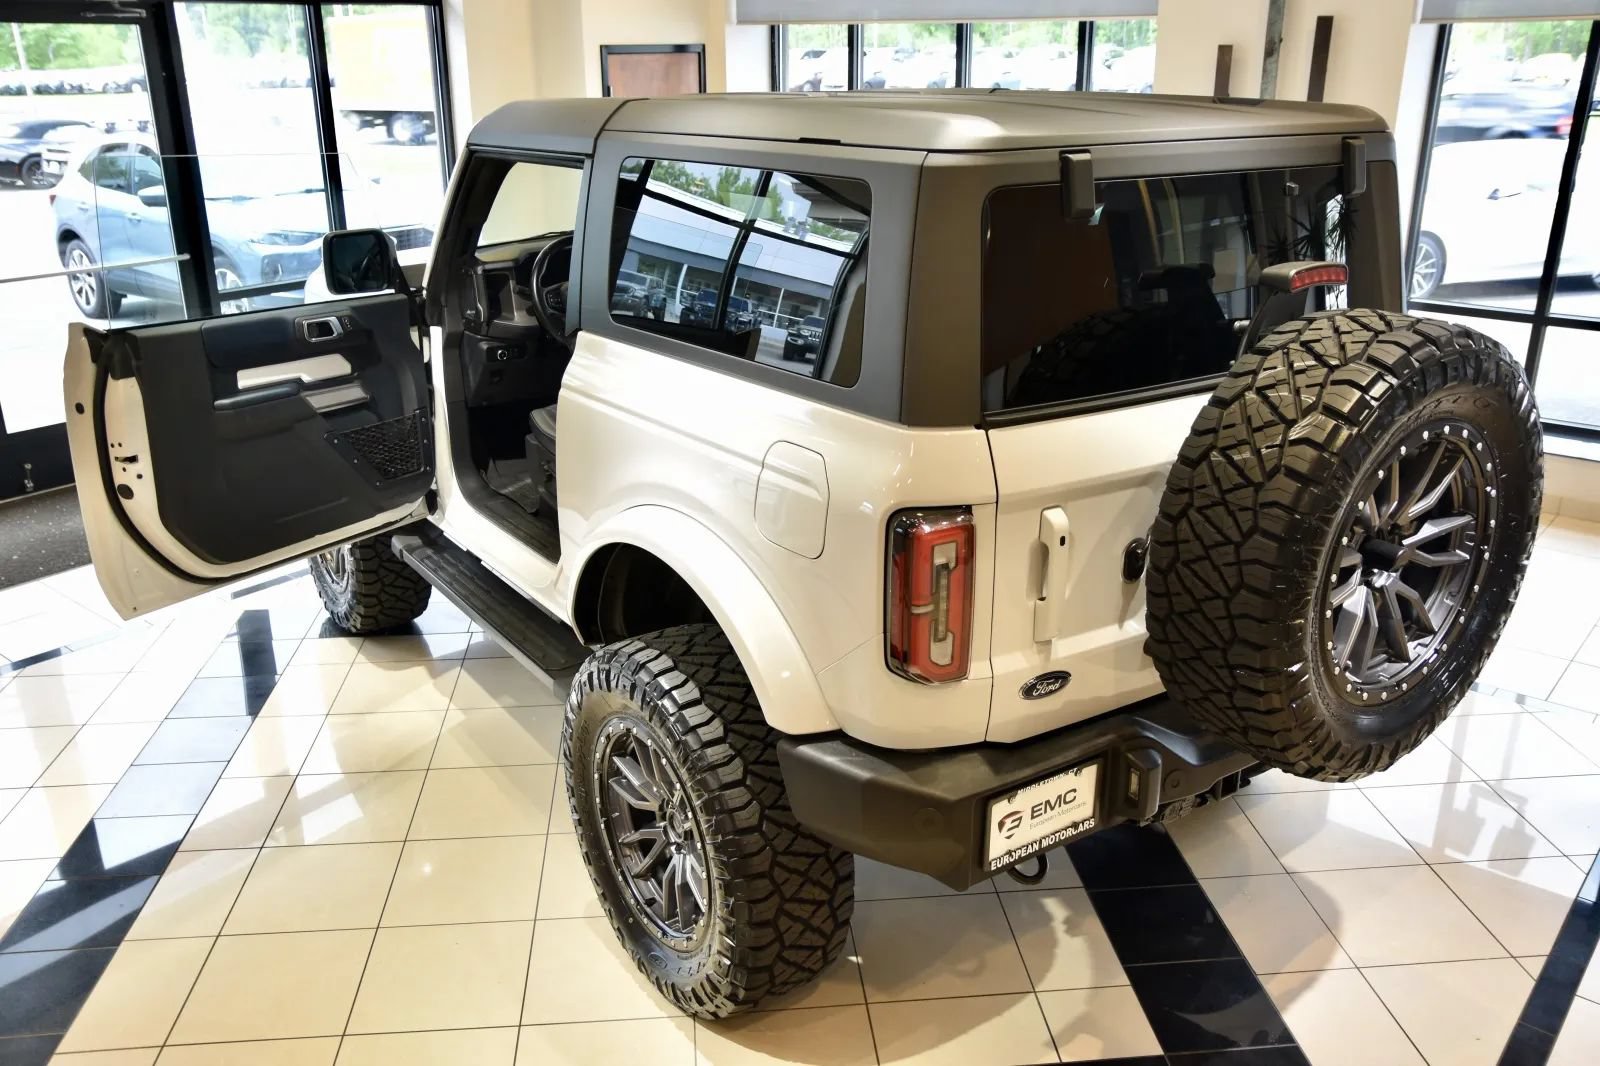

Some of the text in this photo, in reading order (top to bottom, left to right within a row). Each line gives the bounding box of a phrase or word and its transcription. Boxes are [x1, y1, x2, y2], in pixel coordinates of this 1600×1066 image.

[1032, 679, 1061, 697] Ford
[1031, 788, 1077, 820] EMC
[990, 818, 1095, 871] EUROPEAN MOTORCARS
